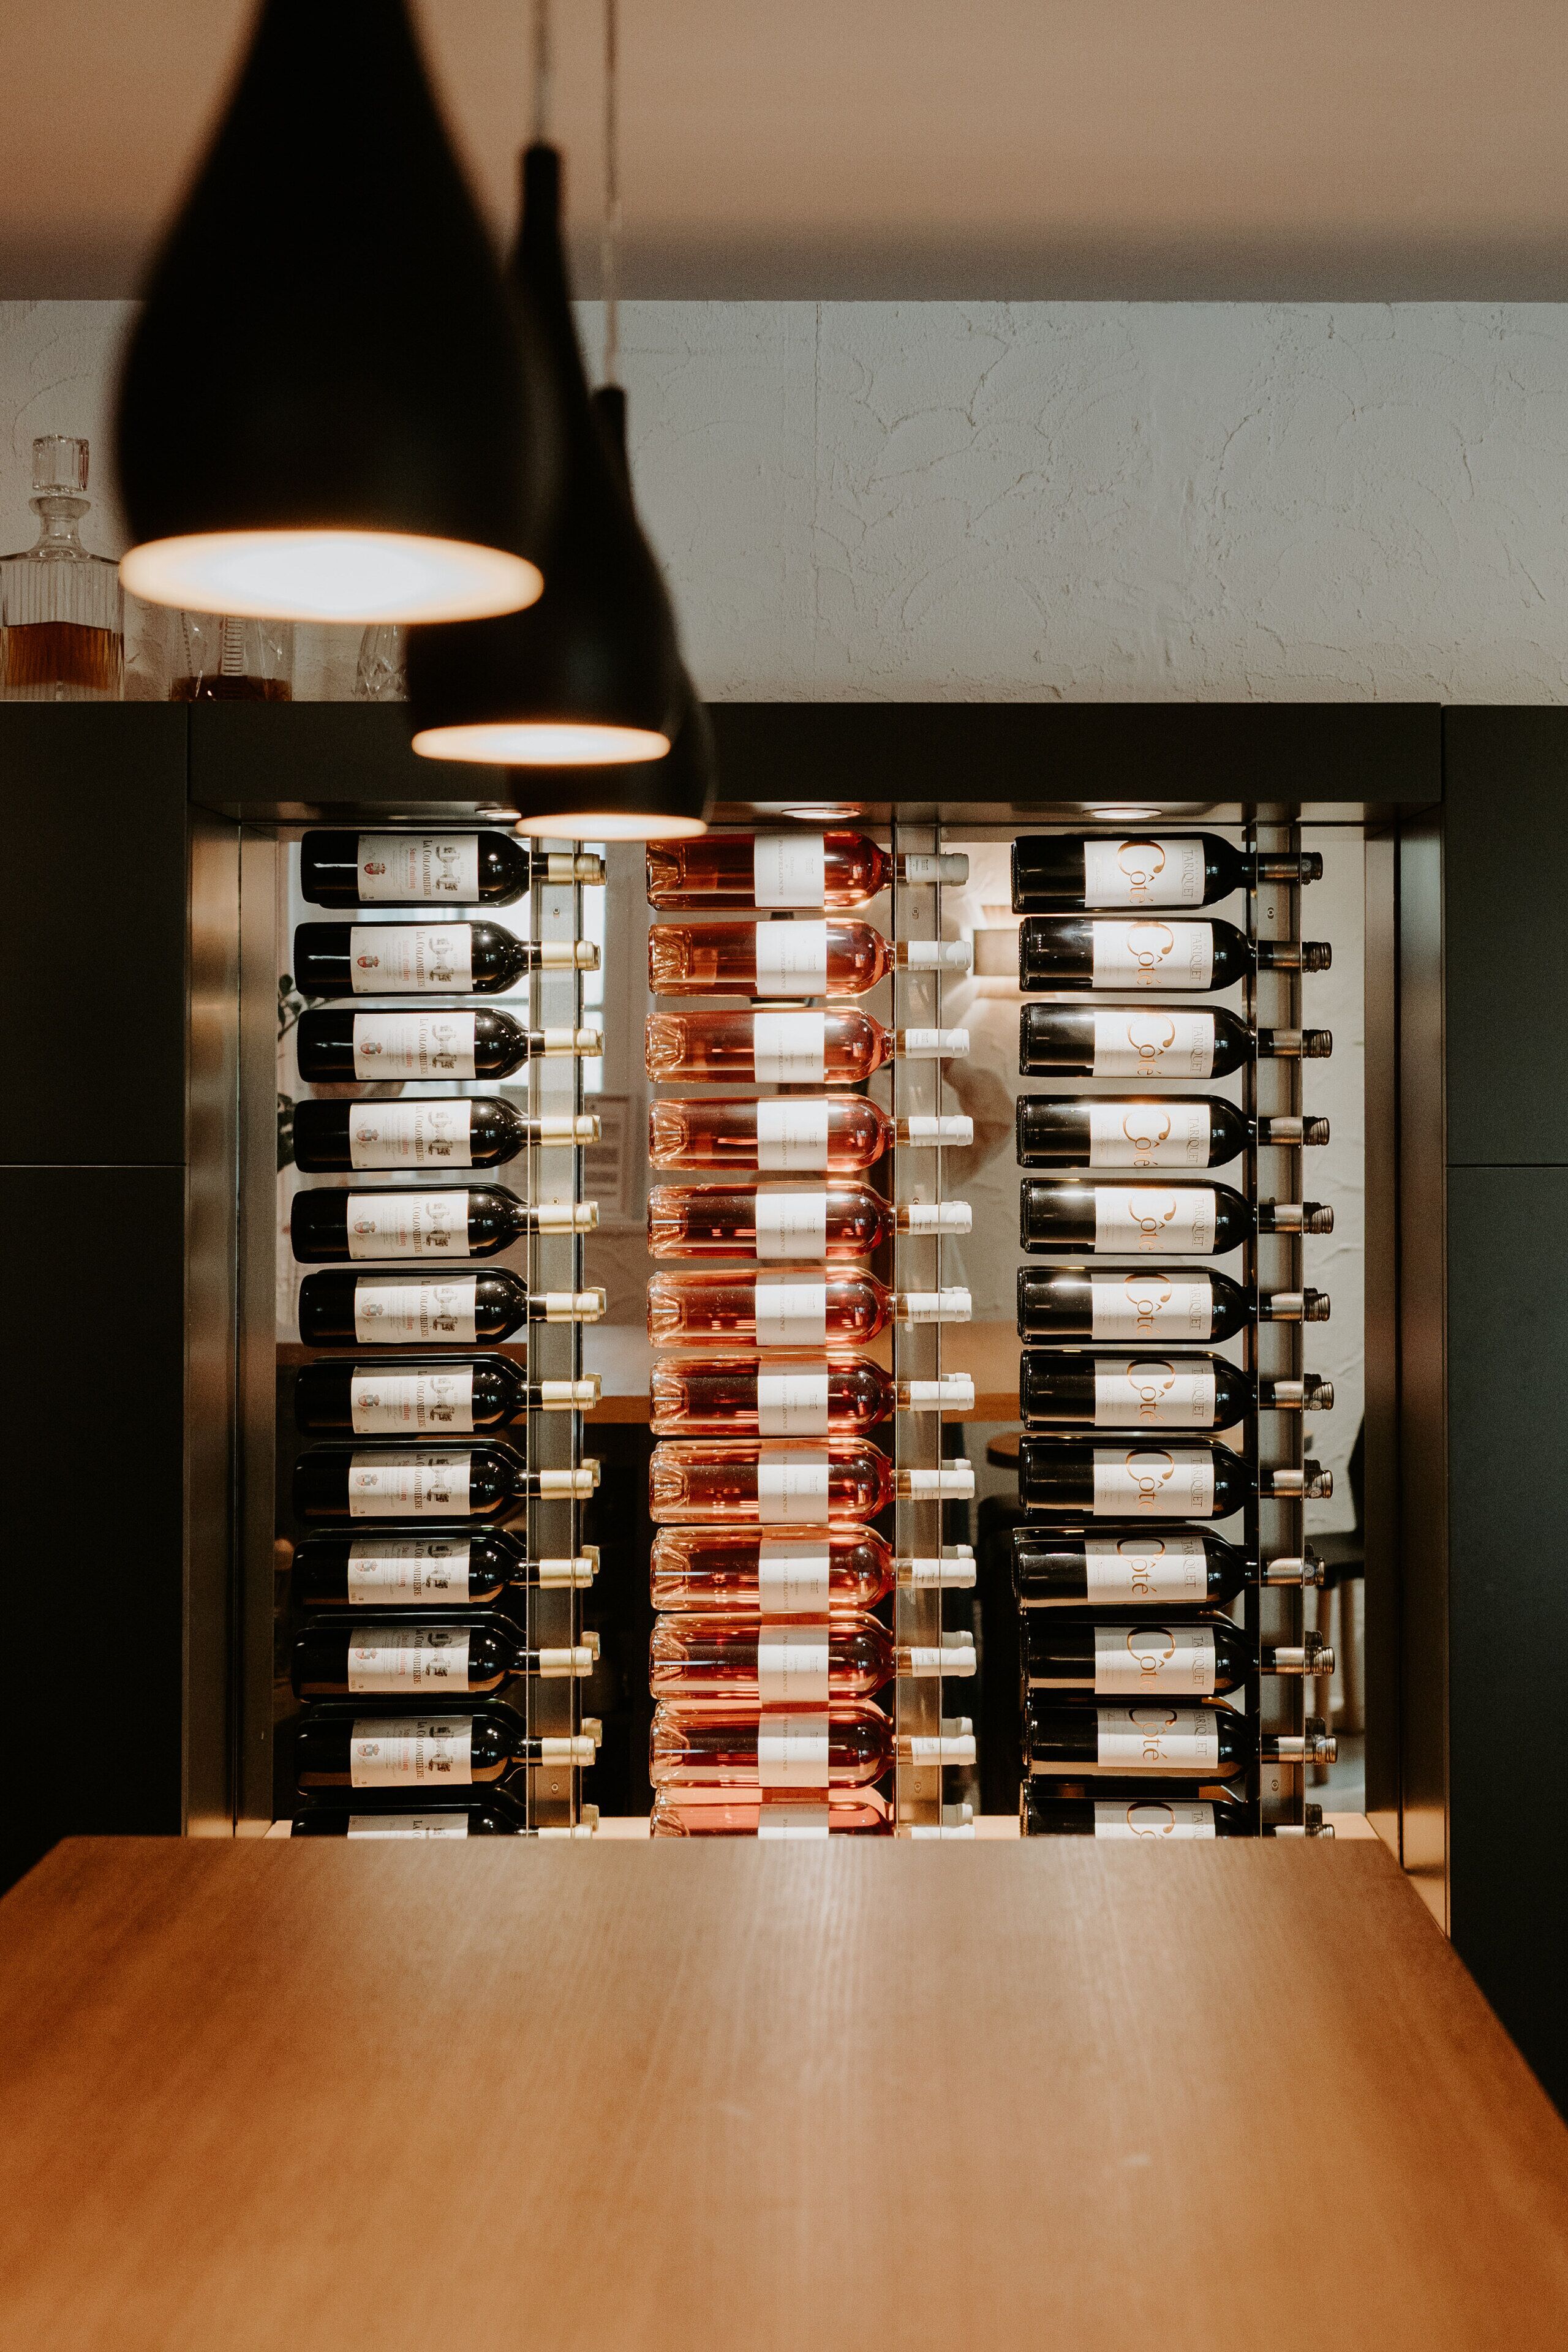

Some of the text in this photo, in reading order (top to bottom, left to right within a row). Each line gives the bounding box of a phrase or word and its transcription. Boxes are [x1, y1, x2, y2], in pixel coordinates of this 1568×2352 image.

[423, 850, 435, 896] COLOMBIÈRE
[1117, 840, 1166, 903] Côté
[1182, 850, 1194, 898] TARIQUET
[417, 942, 428, 987] COLOMBIÈRE
[1127, 921, 1174, 985] Côté
[1190, 932, 1202, 981] TARIQUET
[419, 1029, 431, 1075] COLOMBIÈRE
[1128, 1013, 1175, 1076] Côté
[1190, 1025, 1203, 1072] TARIQUET
[415, 1115, 427, 1162] COLOMBIÈRE
[1123, 1108, 1171, 1166] Côté
[1186, 1117, 1199, 1163] TARIQUET
[413, 1207, 424, 1253] COLOMBIÈRE
[1128, 1189, 1177, 1250] Côté
[1192, 1199, 1204, 1246] TARIQUET
[420, 1291, 431, 1337] COLOMBIÈRE
[1124, 1274, 1172, 1335] Côté
[417, 1381, 428, 1427] COLOMBIÈRE
[1126, 1360, 1175, 1422] Côté
[1192, 1368, 1204, 1417] TARIQUET
[414, 1462, 426, 1510] COLOMBIÈRE
[1126, 1450, 1174, 1512] Côté
[1191, 1458, 1203, 1507] TARIQUET
[413, 1549, 424, 1596] COLOMBIÈRE
[1117, 1540, 1166, 1595] Côté
[1182, 1541, 1196, 1587] TARIQUET
[413, 1637, 424, 1684] COLOMBIÈRE
[1127, 1629, 1175, 1690] Côté
[1193, 1637, 1204, 1685] TARIQUET
[416, 1730, 427, 1779] COLOMBIÈRE
[1129, 1709, 1177, 1760] Côté
[413, 1820, 422, 1829] LA
[1127, 1803, 1175, 1839] Cô
[1193, 1811, 1204, 1839] TARIQ
